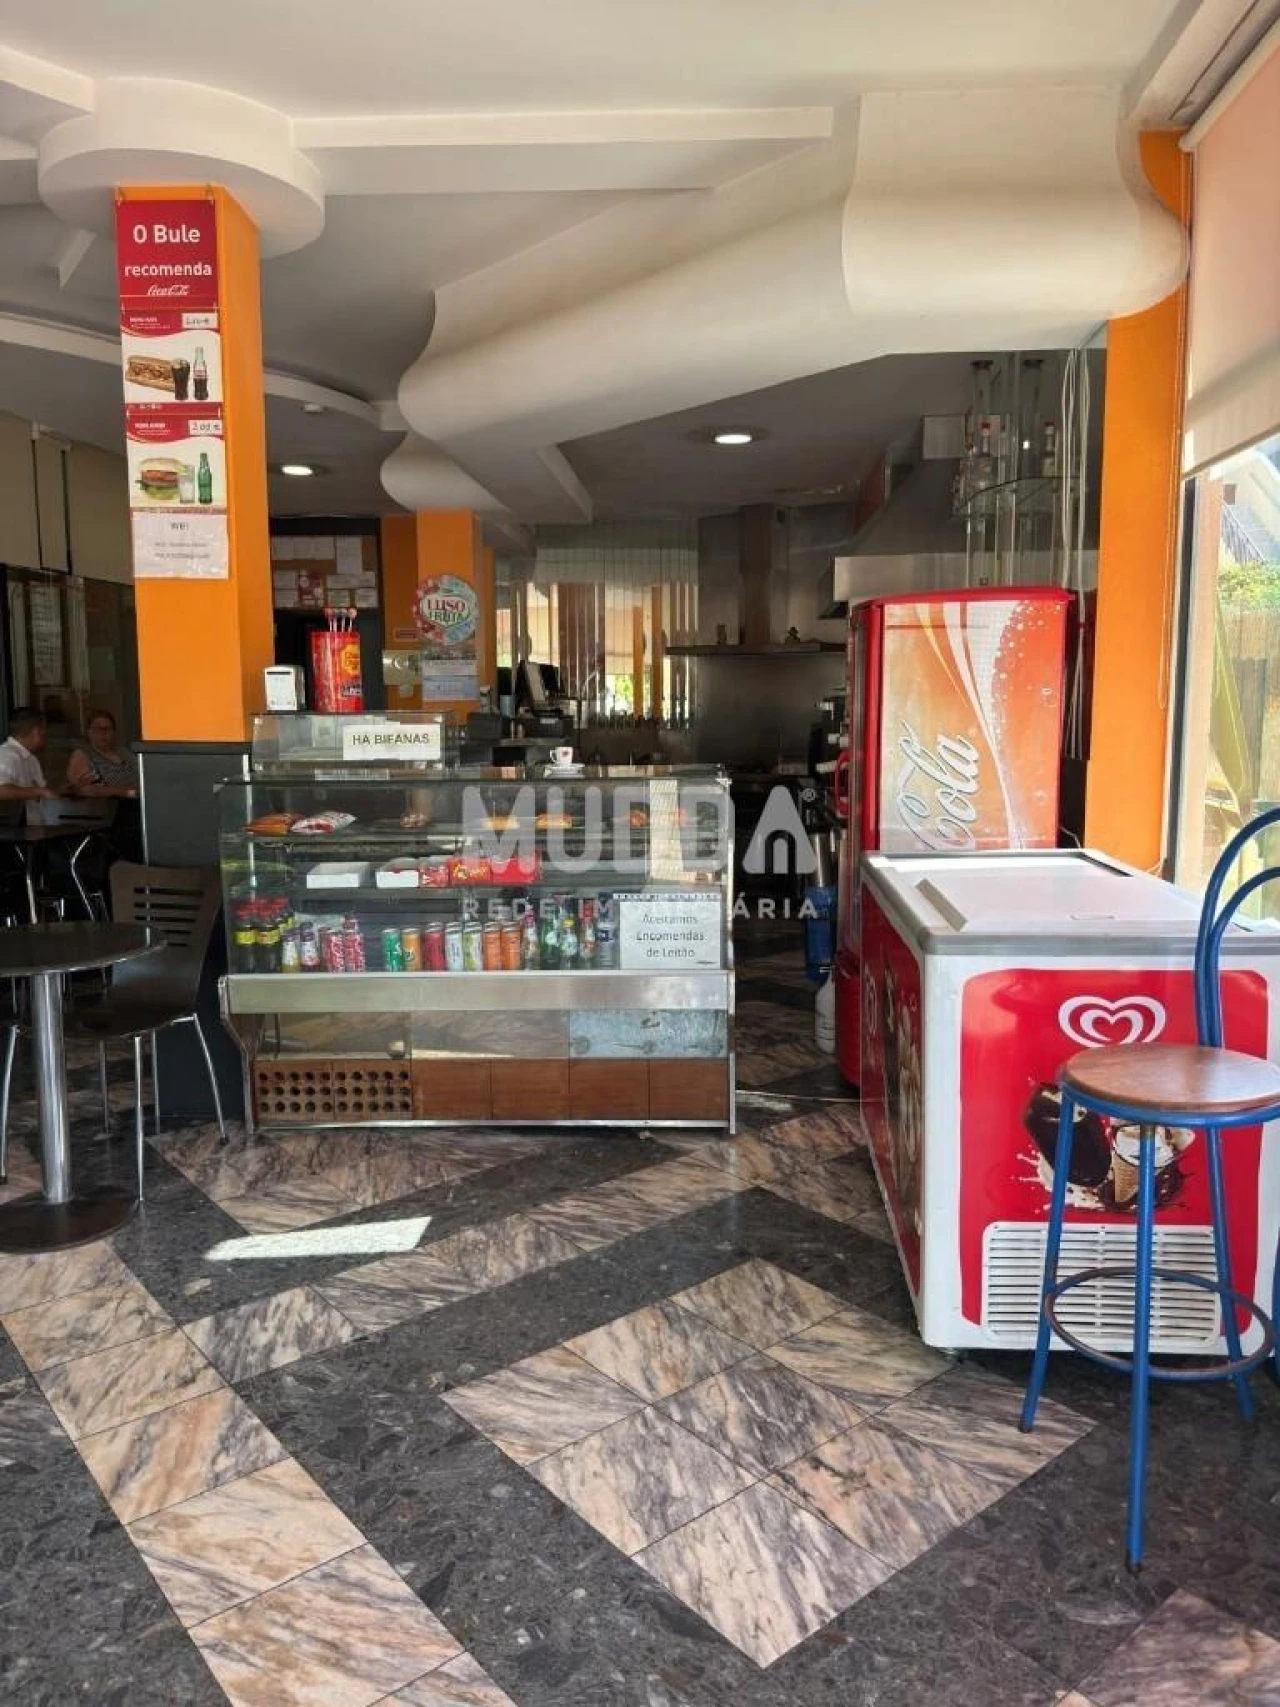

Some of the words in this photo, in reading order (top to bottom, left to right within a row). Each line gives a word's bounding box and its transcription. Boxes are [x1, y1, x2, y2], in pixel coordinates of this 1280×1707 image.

[133, 225, 147, 243] O
[153, 224, 200, 244] Bule
[124, 262, 213, 276] recomenda
[375, 733, 430, 745] BIFANAS
[643, 913, 698, 924] Aceitamos
[636, 930, 704, 942] Encomendas
[646, 947, 660, 958] de
